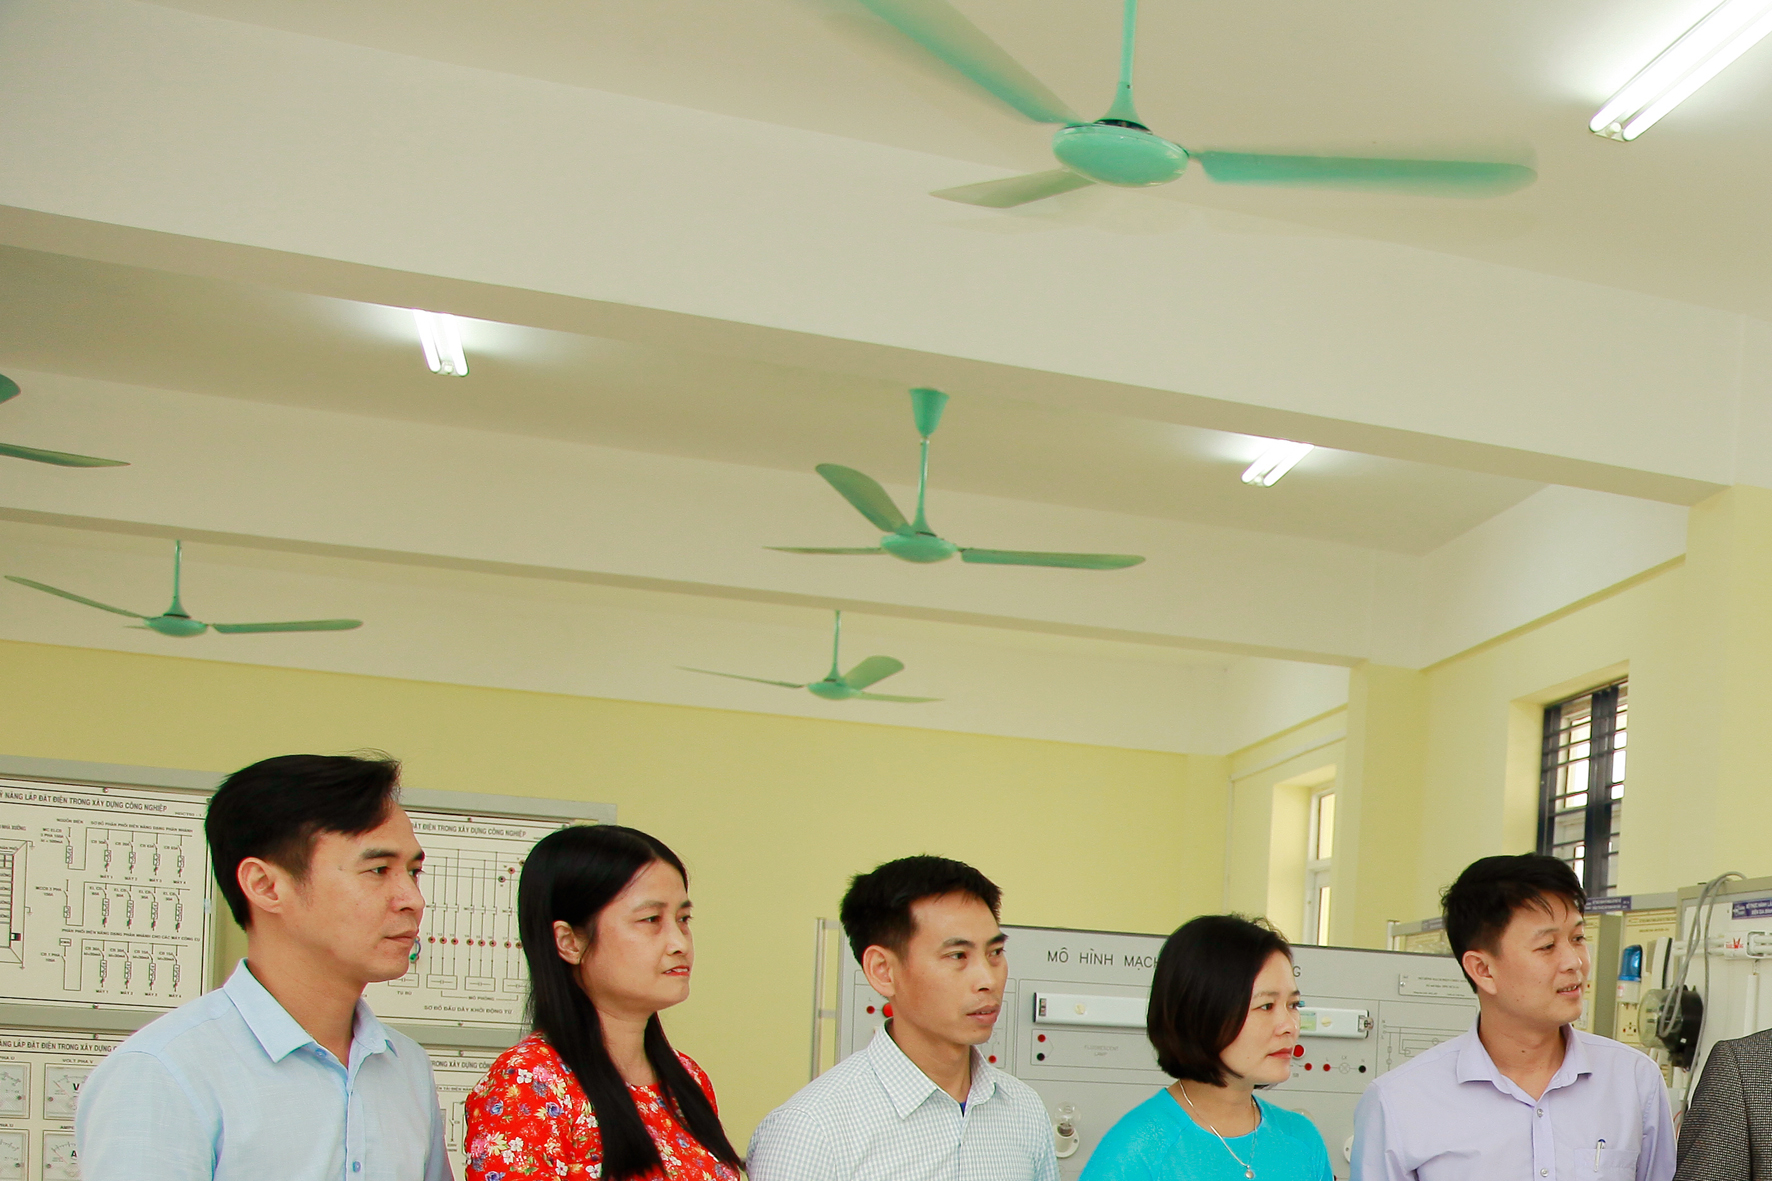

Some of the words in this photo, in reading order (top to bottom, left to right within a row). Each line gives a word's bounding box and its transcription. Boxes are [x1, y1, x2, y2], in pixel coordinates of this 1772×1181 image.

[69, 797, 91, 806] TRONG
[92, 798, 104, 807] XÂY
[125, 800, 142, 810] CÔNG
[437, 825, 457, 833] TRONG
[458, 825, 470, 834] XÂY
[1047, 947, 1069, 963] MÔ
[1080, 948, 1114, 966] HÌNH
[73, 1083, 80, 1091] V
[70, 1150, 78, 1158] A
